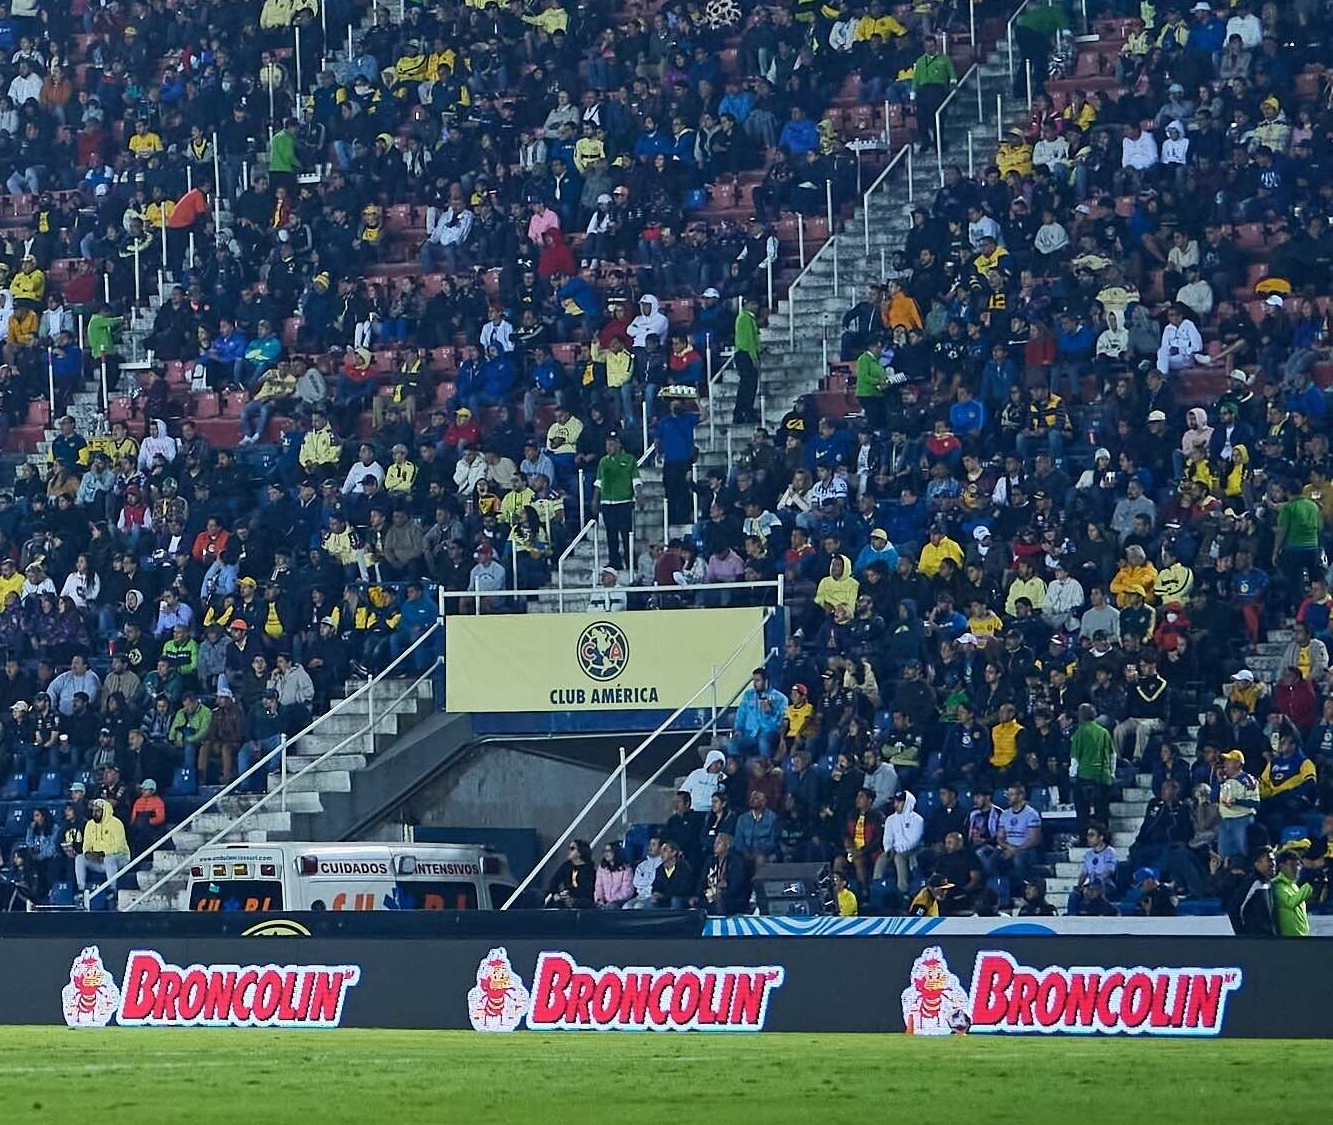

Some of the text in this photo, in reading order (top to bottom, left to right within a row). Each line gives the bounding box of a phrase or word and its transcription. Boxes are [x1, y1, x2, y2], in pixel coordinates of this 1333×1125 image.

[549, 684, 659, 704] CLUB AMÉRICA
[321, 862, 479, 875] CUIDADOS INTENSIVOS
[124, 956, 344, 1020] BRONCOLIN
[536, 958, 764, 1025] BRONCOLIN
[973, 958, 1221, 1028] BRONCOLIN
